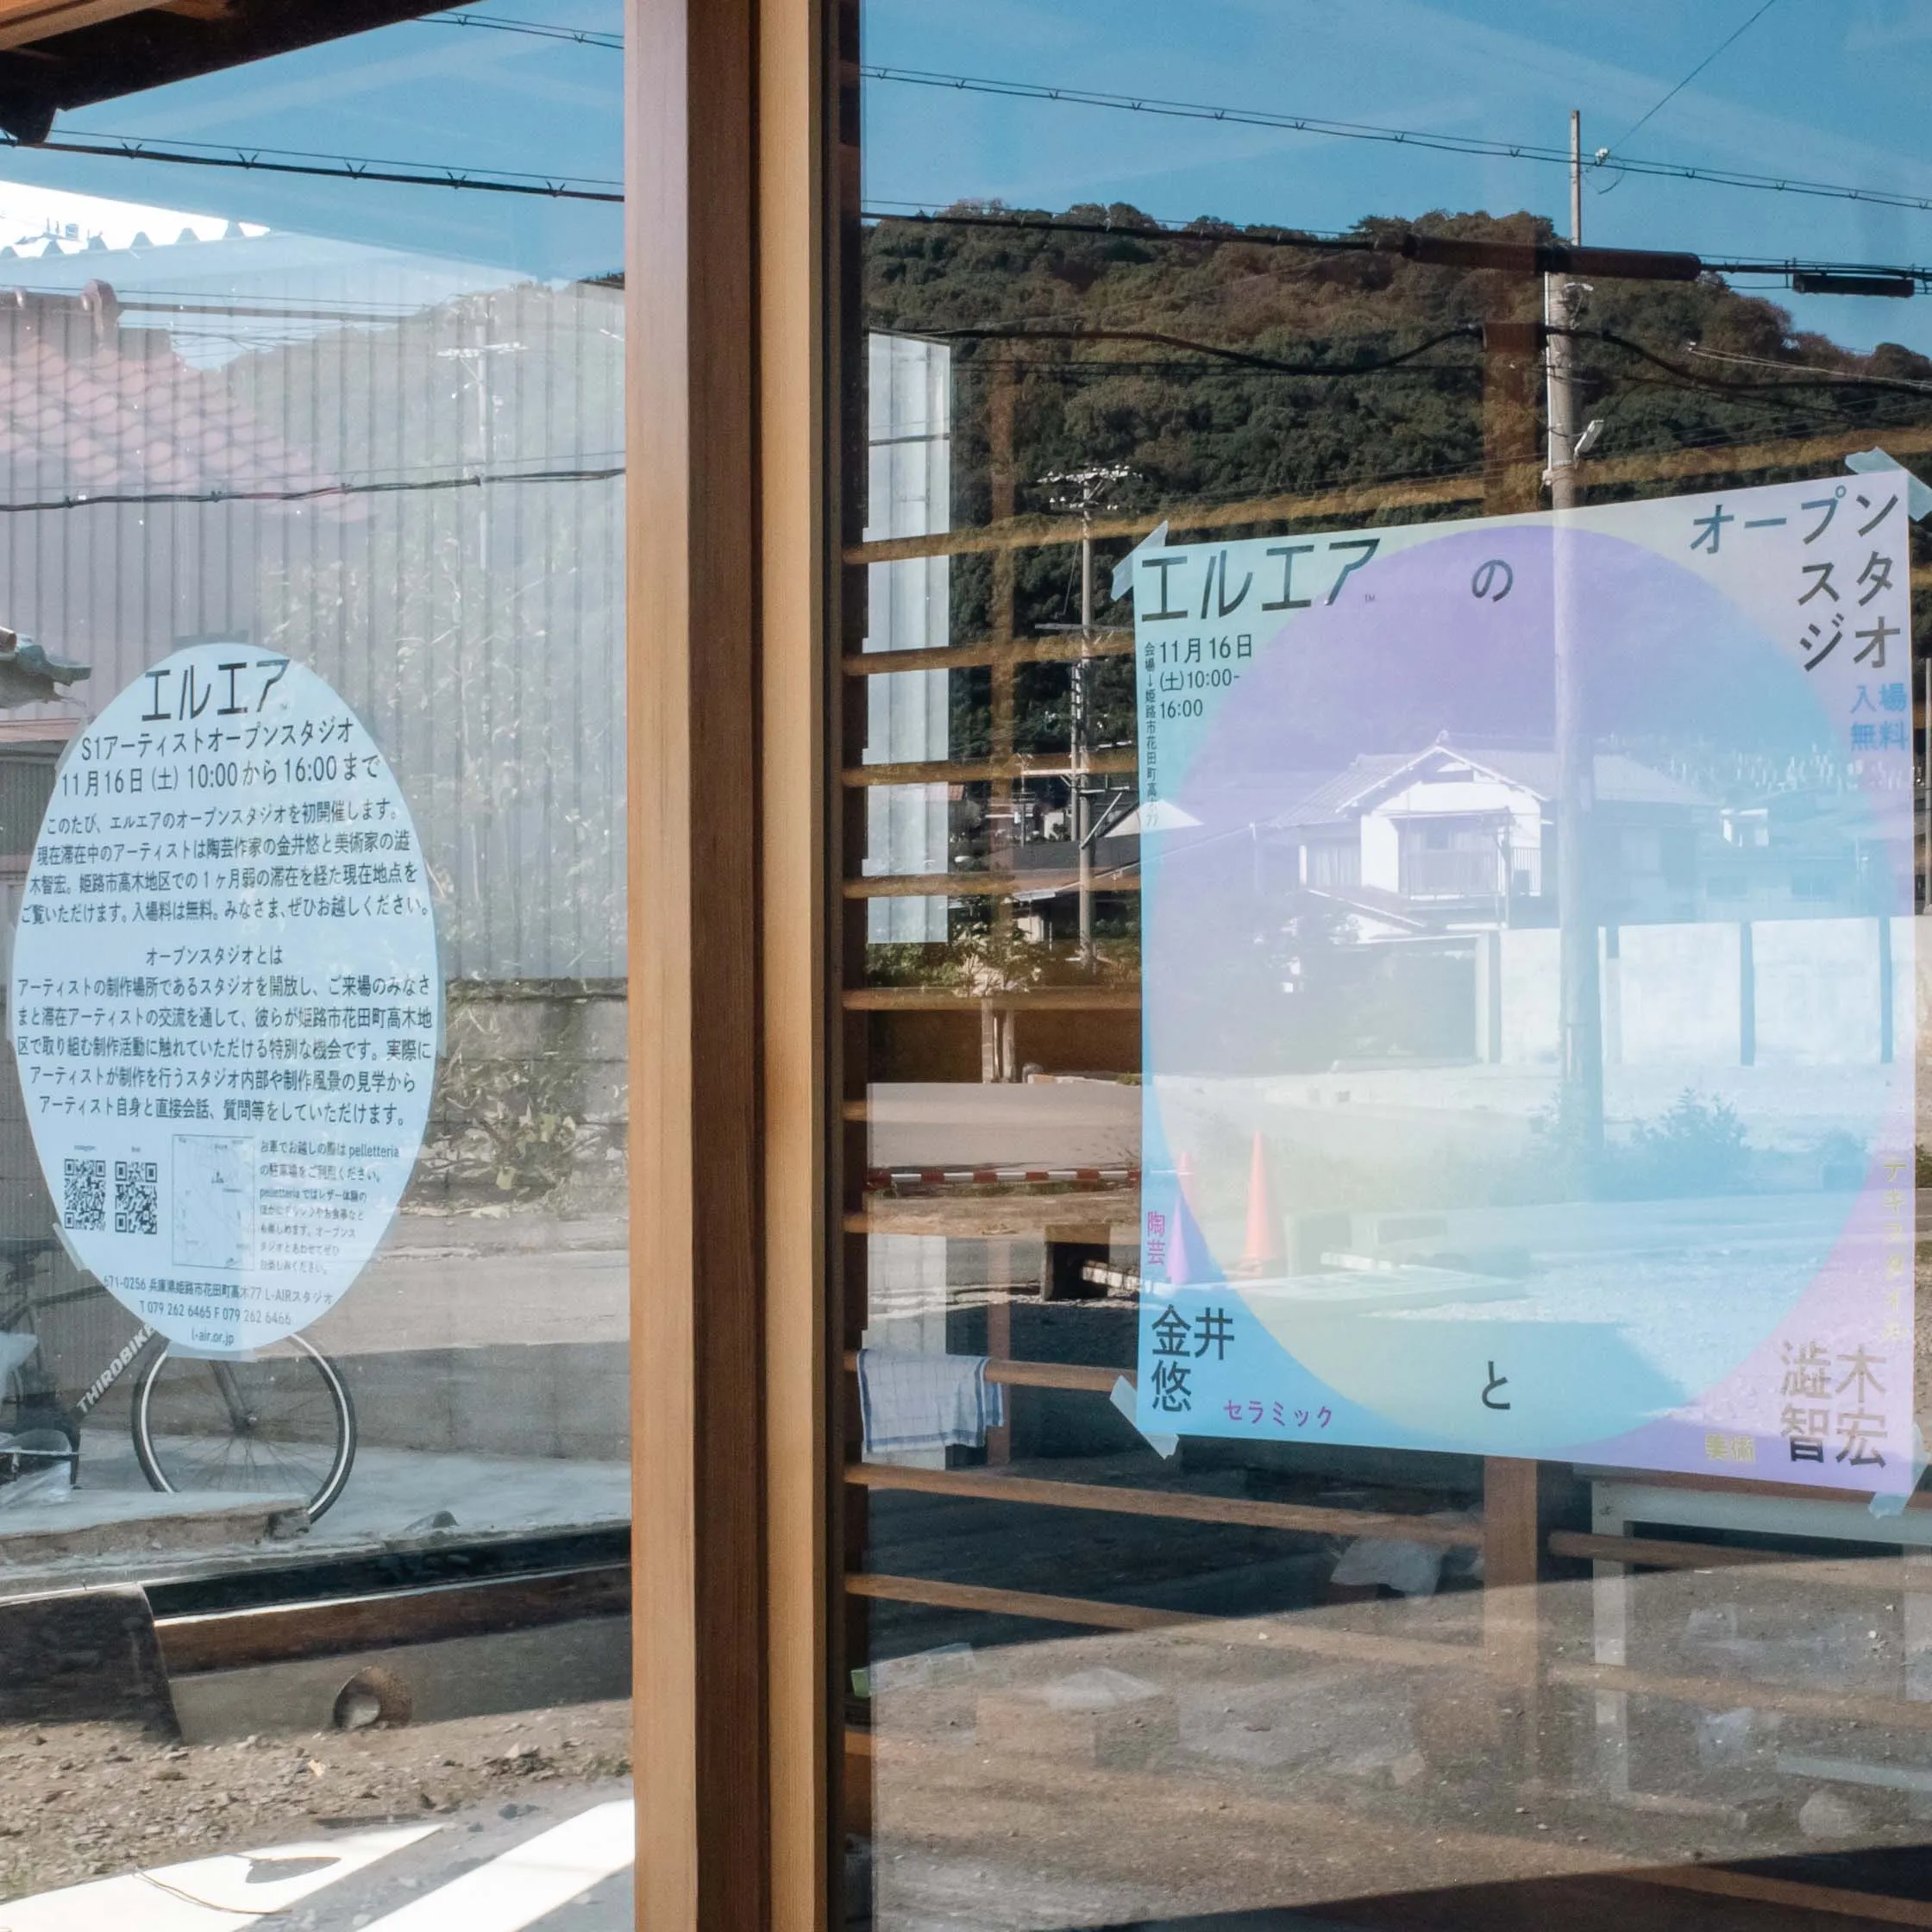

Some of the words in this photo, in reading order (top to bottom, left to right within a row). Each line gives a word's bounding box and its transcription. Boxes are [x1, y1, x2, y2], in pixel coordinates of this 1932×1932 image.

[1690, 486, 1899, 555] オープン
[1141, 538, 1381, 623] エルエア
[1471, 559, 1514, 604] の
[1160, 633, 1252, 664] 11月16日
[141, 658, 291, 722] エルエア
[1159, 698, 1204, 720] 16:00
[1480, 1360, 1511, 1411] と
[1223, 1399, 1334, 1430] セラミック
